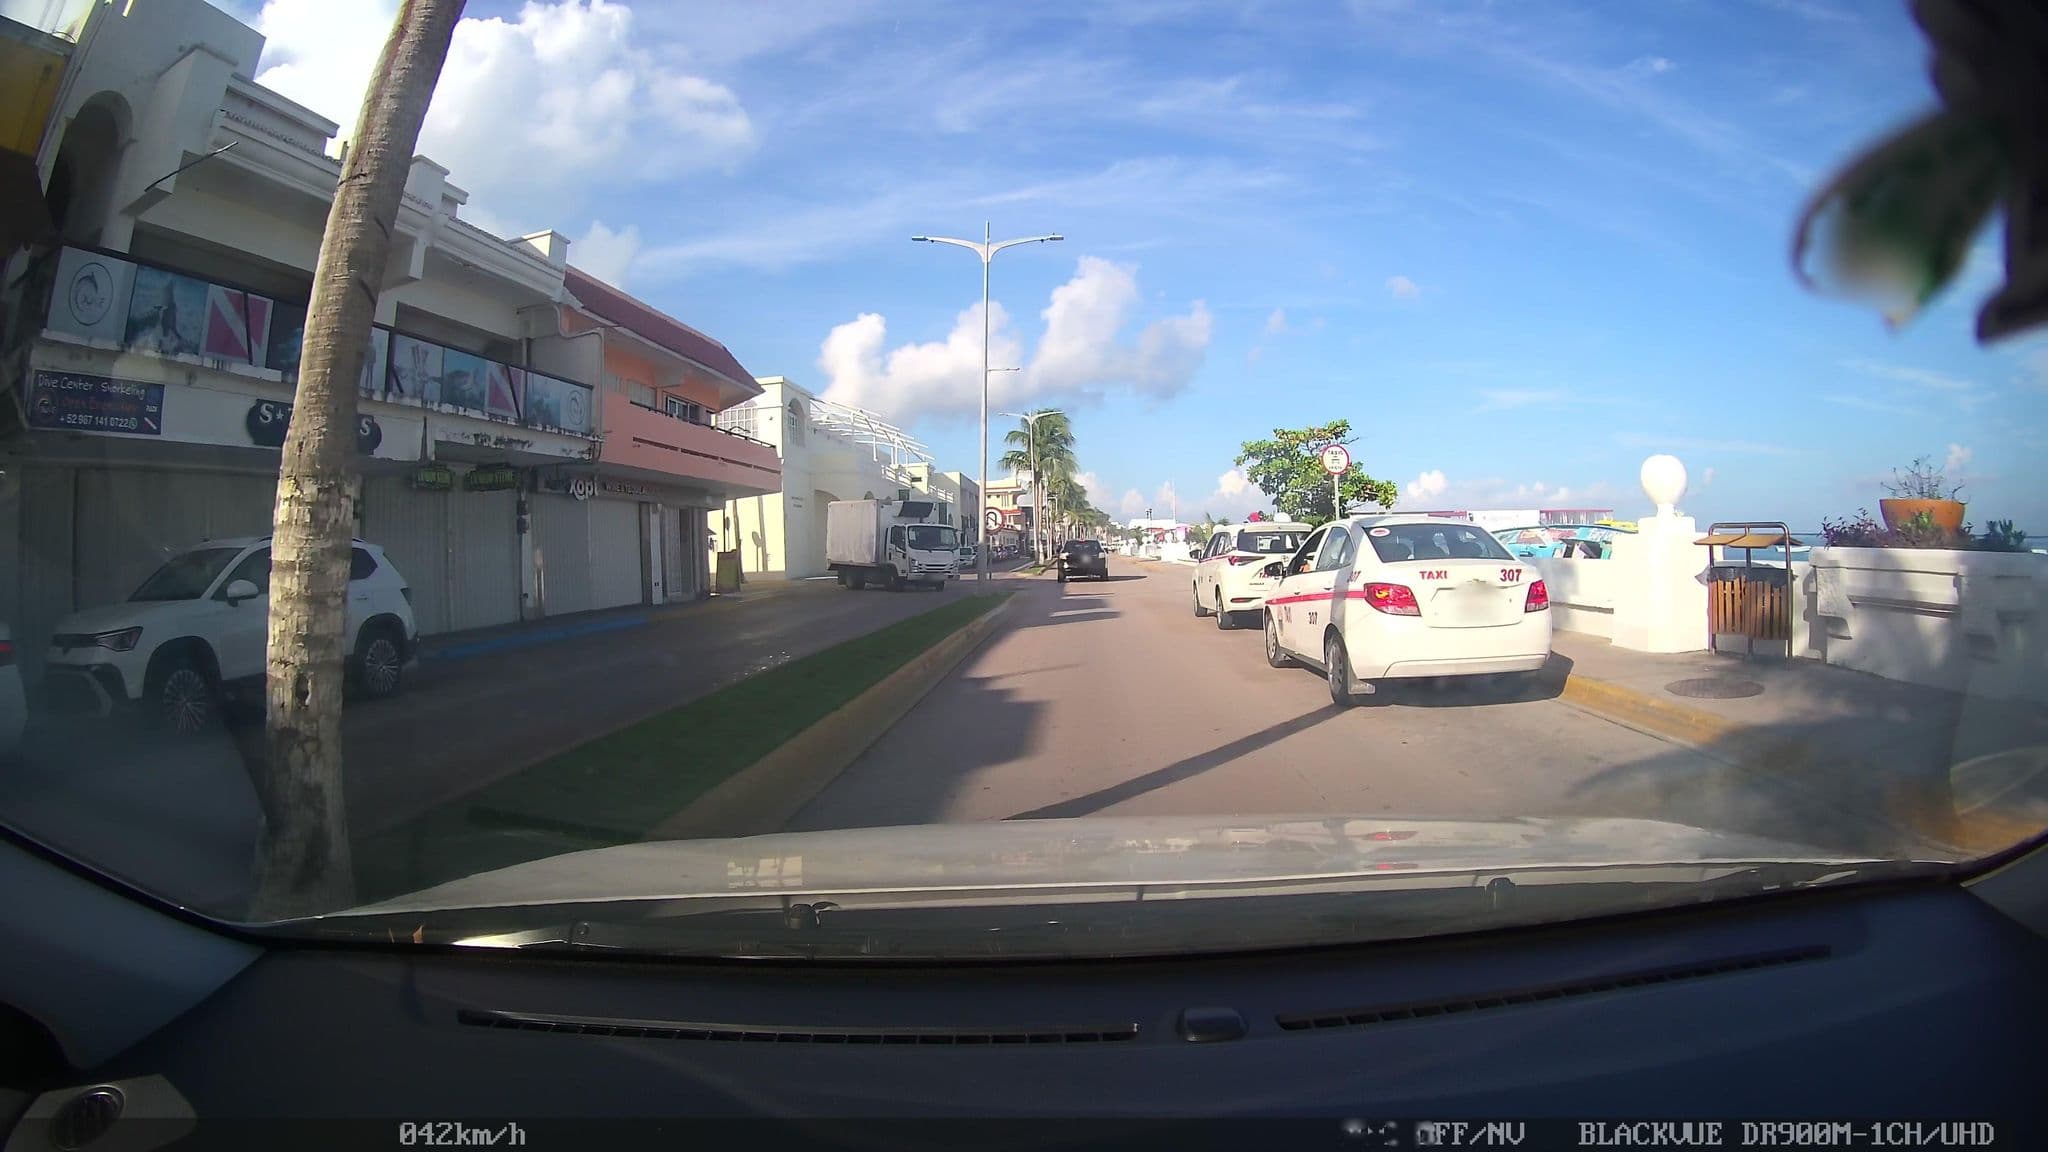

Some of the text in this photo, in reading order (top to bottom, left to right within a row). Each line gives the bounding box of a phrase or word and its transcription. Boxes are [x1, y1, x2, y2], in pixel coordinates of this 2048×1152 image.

[38, 374, 58, 388] Dive
[60, 377, 93, 391] Center
[66, 413, 77, 424] 52
[1419, 570, 1448, 580] TAXI
[1499, 568, 1522, 582] 307
